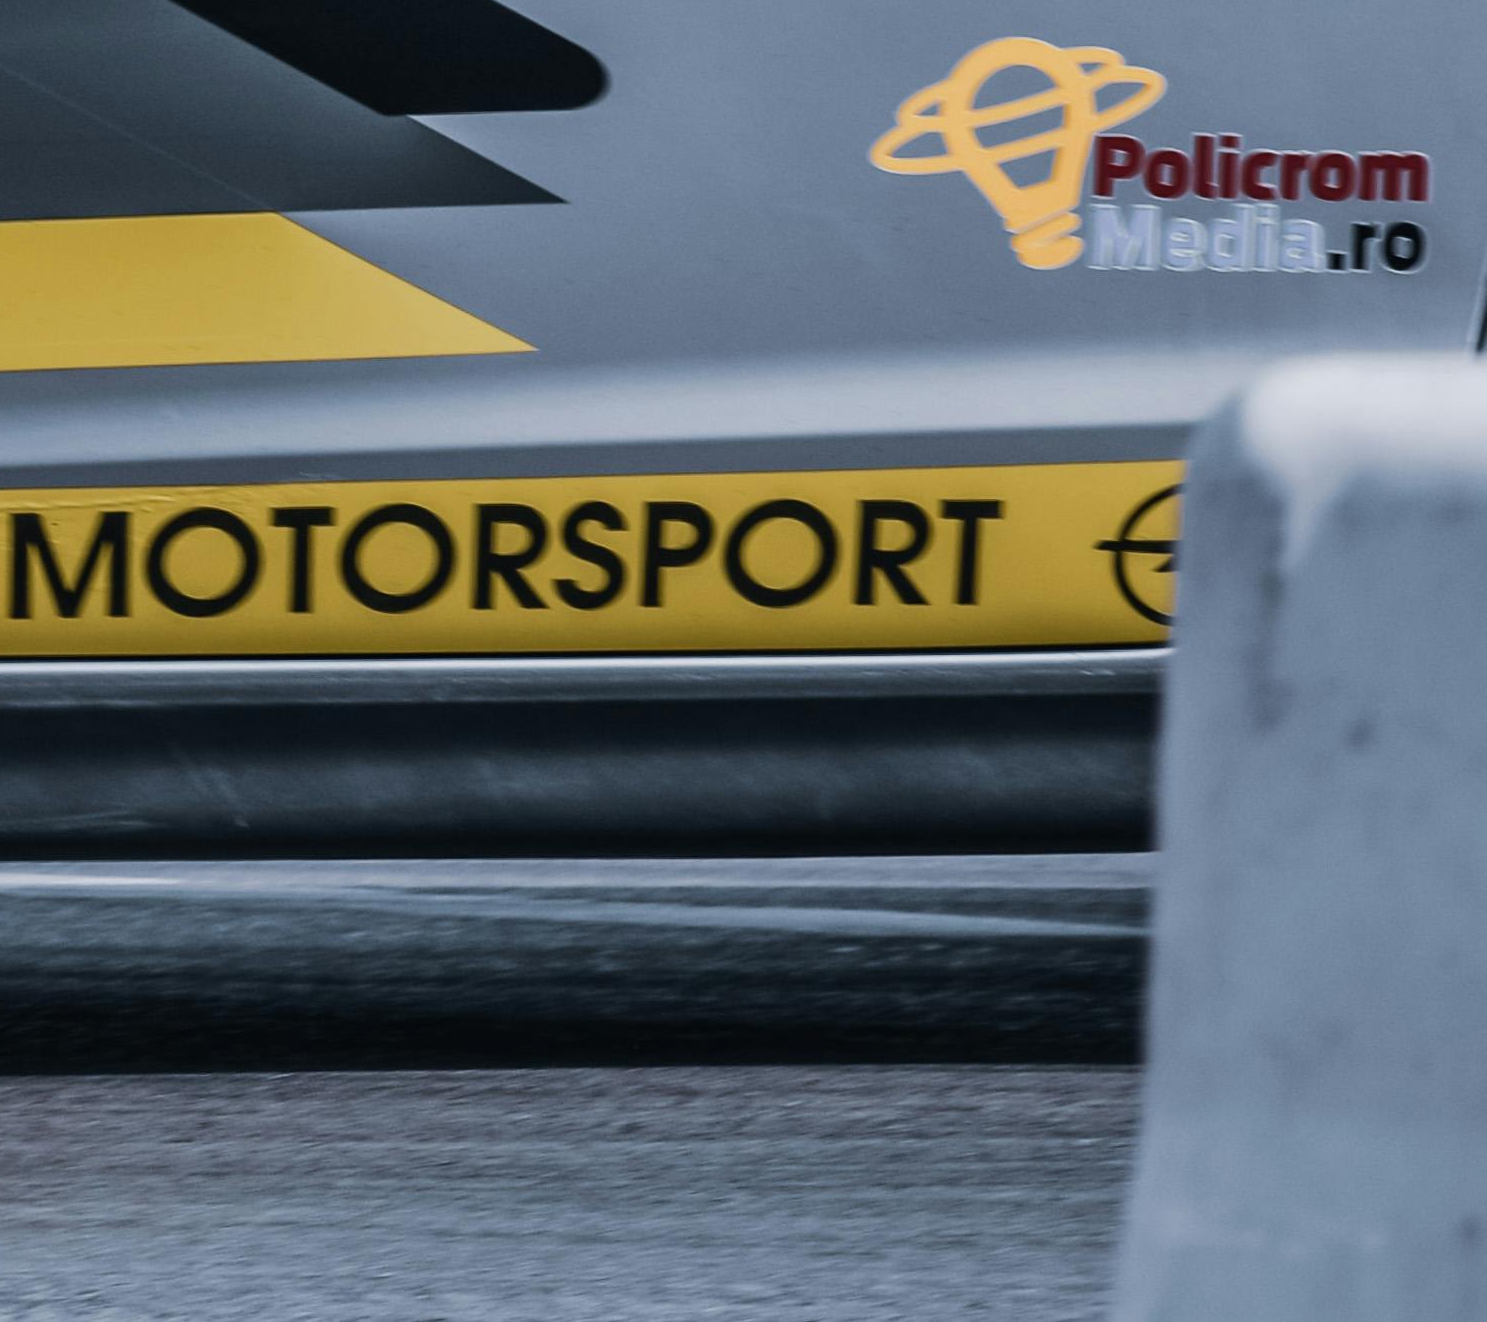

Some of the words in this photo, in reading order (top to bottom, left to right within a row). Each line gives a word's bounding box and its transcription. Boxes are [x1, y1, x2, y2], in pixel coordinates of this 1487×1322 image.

[1092, 132, 1430, 202] Policrom
[1088, 203, 1426, 272] Media.ro
[7, 497, 1004, 620] MOTORSPORT
